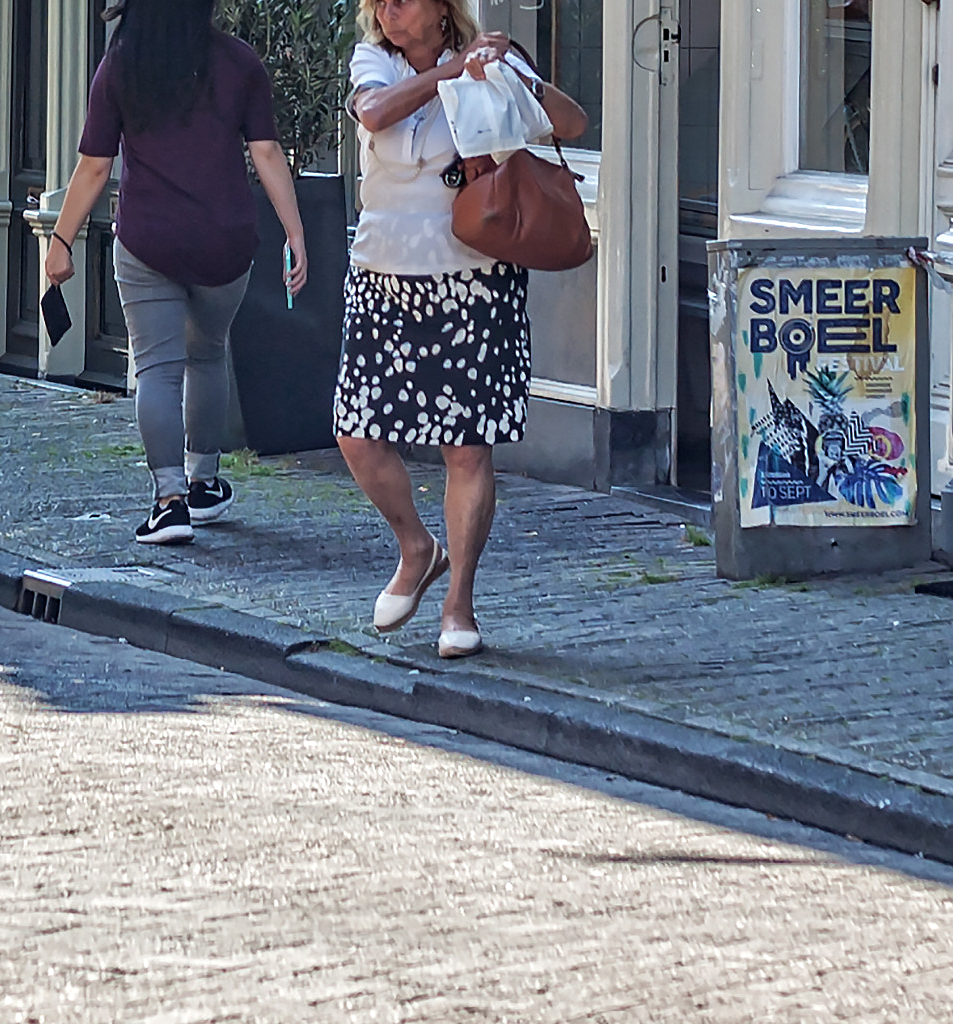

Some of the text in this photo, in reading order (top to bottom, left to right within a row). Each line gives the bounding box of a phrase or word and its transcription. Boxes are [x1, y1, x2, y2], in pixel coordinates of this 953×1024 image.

[749, 279, 901, 315] SMEER
[750, 317, 897, 354] BOEL
[761, 485, 811, 500] 10 SEPT
